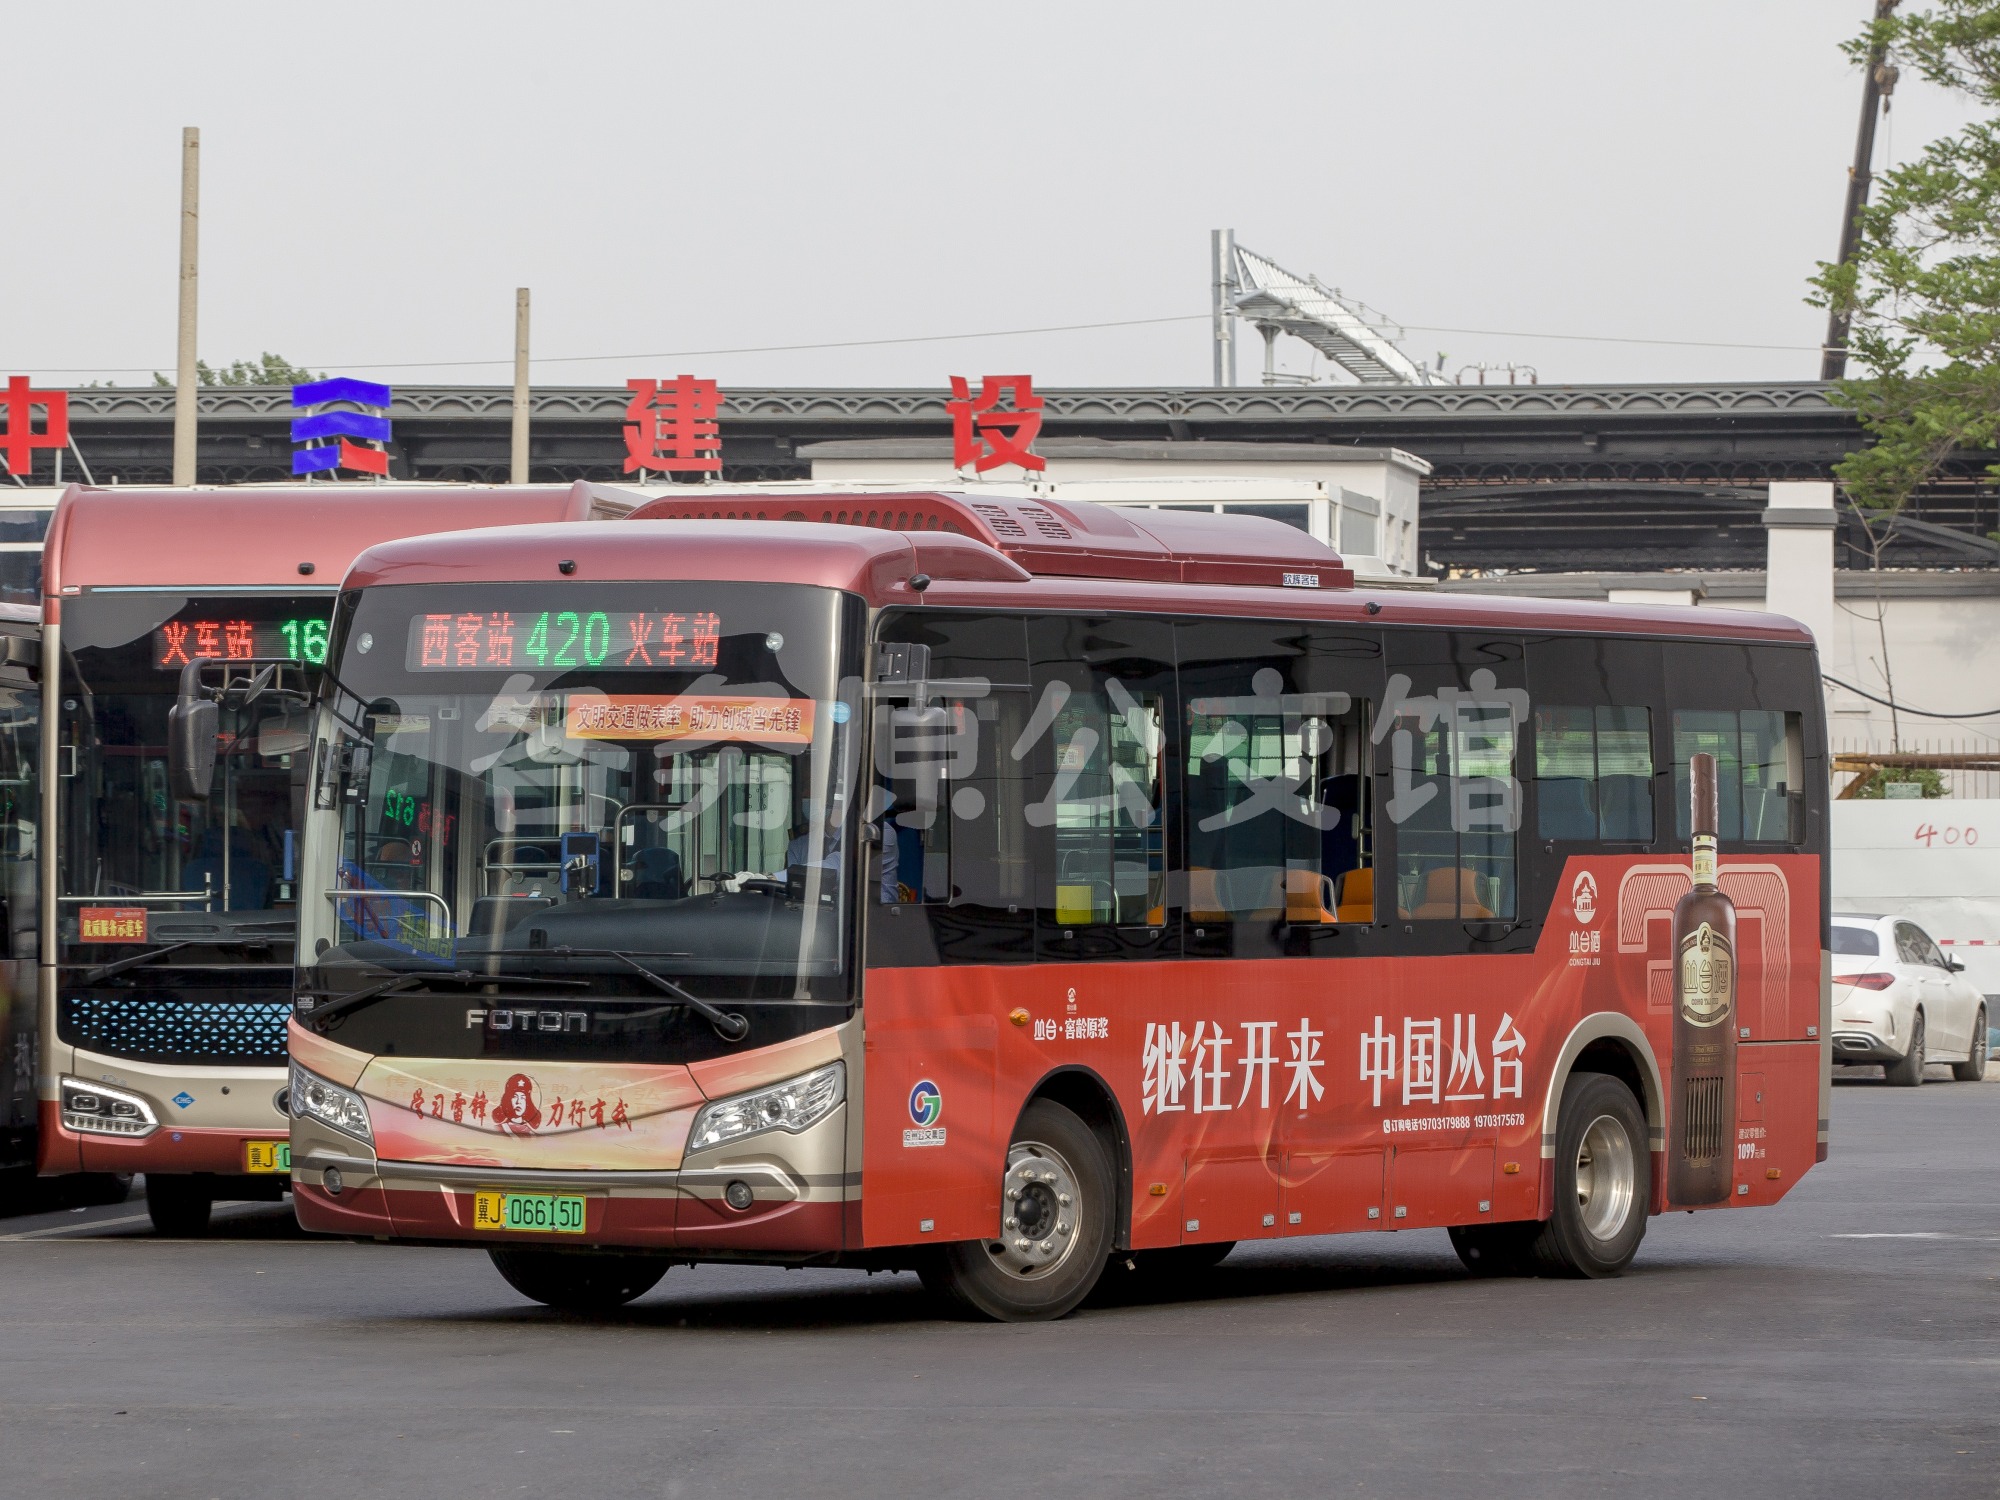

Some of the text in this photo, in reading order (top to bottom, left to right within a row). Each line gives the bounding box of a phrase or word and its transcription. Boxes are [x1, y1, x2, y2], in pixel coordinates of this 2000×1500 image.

[0, 375, 69, 475] 中
[1283, 574, 1318, 586] 欧辉客车
[161, 620, 253, 664] 火车站
[421, 611, 720, 667] 西客站 420 火车站
[575, 704, 683, 730] 文明交通做表率
[689, 704, 802, 734] 助力创城当先锋
[1914, 822, 1979, 848] 400
[1569, 930, 1601, 953] 丛台酒
[466, 1009, 588, 1032] FOTON
[1142, 1012, 1527, 1116] 继往开来 中国丛台
[410, 1088, 633, 1132] 学习雷锋 力行有我
[1474, 1113, 1525, 1128] 19703175678
